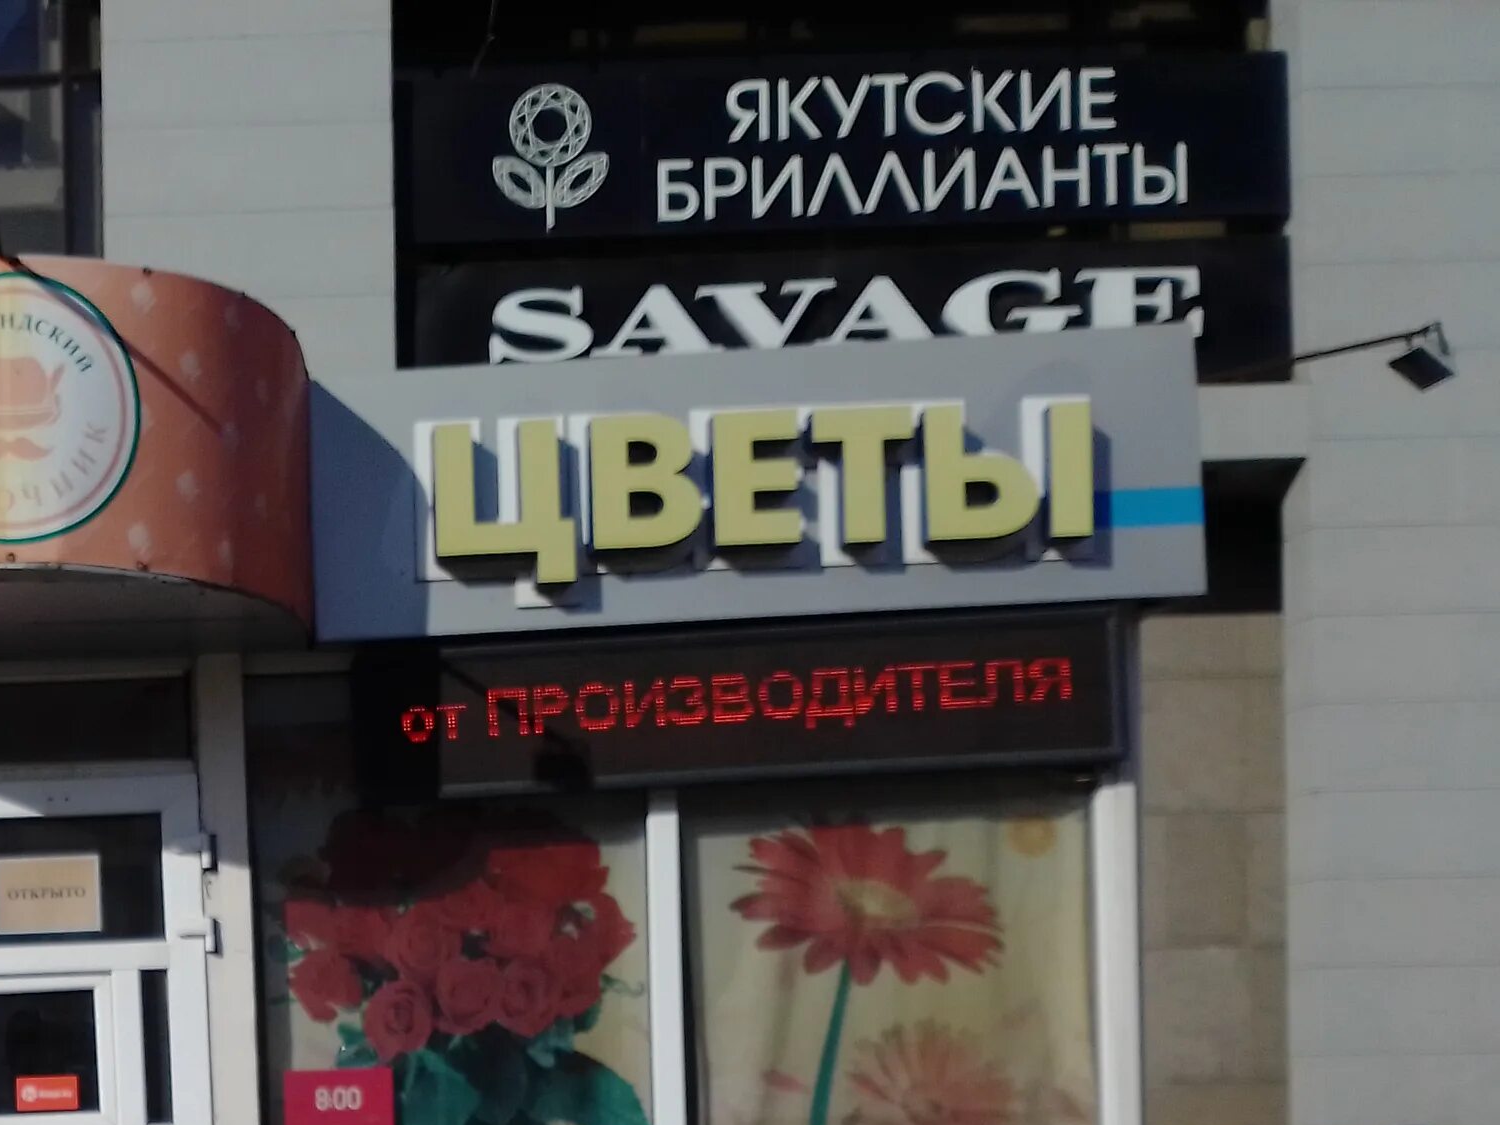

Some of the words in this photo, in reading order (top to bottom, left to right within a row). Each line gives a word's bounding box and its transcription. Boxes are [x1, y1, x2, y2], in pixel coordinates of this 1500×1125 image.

[725, 67, 1119, 144] ЯКУТСКИЕ
[656, 142, 1190, 224] БРИЛЛИАНТЫ
[488, 265, 1205, 366] SAVAGE
[433, 398, 1095, 585] ЦВЕТЫ
[486, 658, 1074, 738] ПРОИЗВОДИТЕЛЯ
